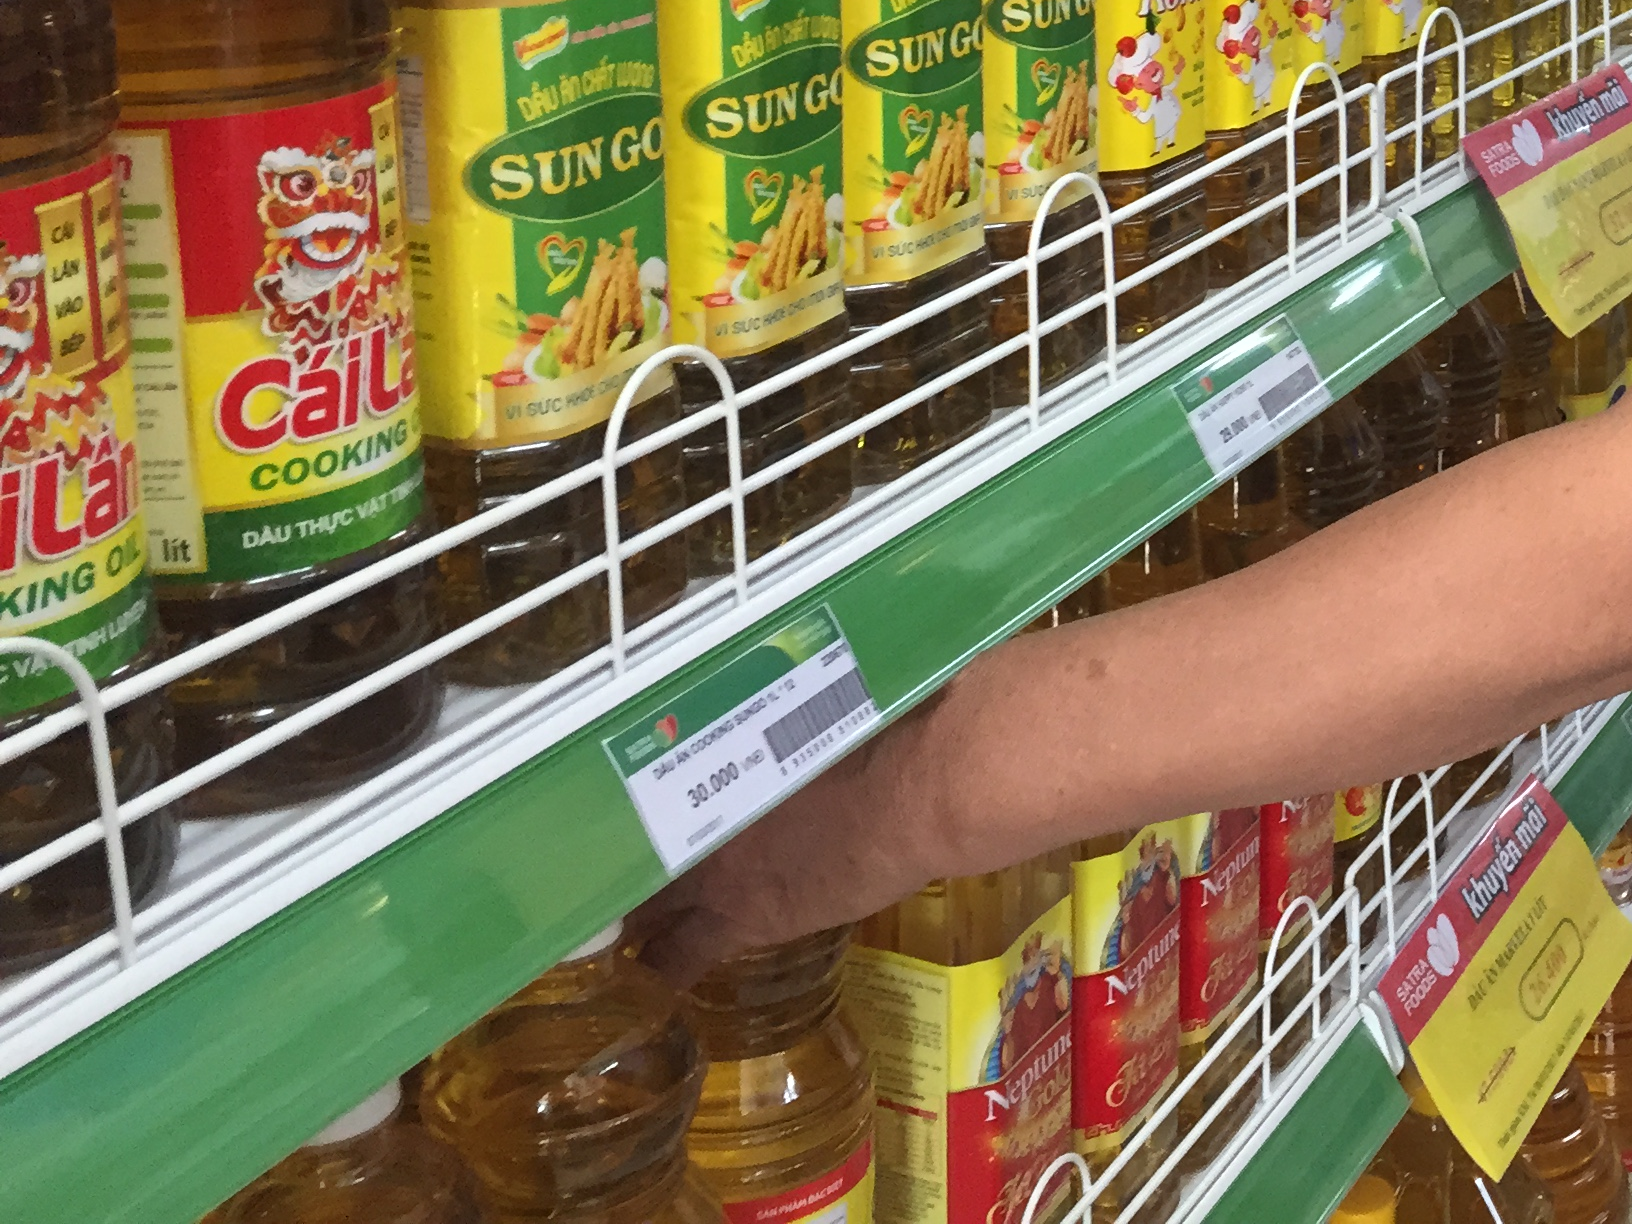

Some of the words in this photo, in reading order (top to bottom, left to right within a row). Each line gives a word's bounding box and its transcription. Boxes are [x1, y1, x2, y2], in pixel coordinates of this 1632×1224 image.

[865, 27, 947, 78] SUN
[705, 82, 800, 140] SUN
[489, 135, 605, 202] SUN
[250, 419, 408, 491] COOKING
[162, 537, 192, 564] lít
[687, 761, 740, 809] 30.000
